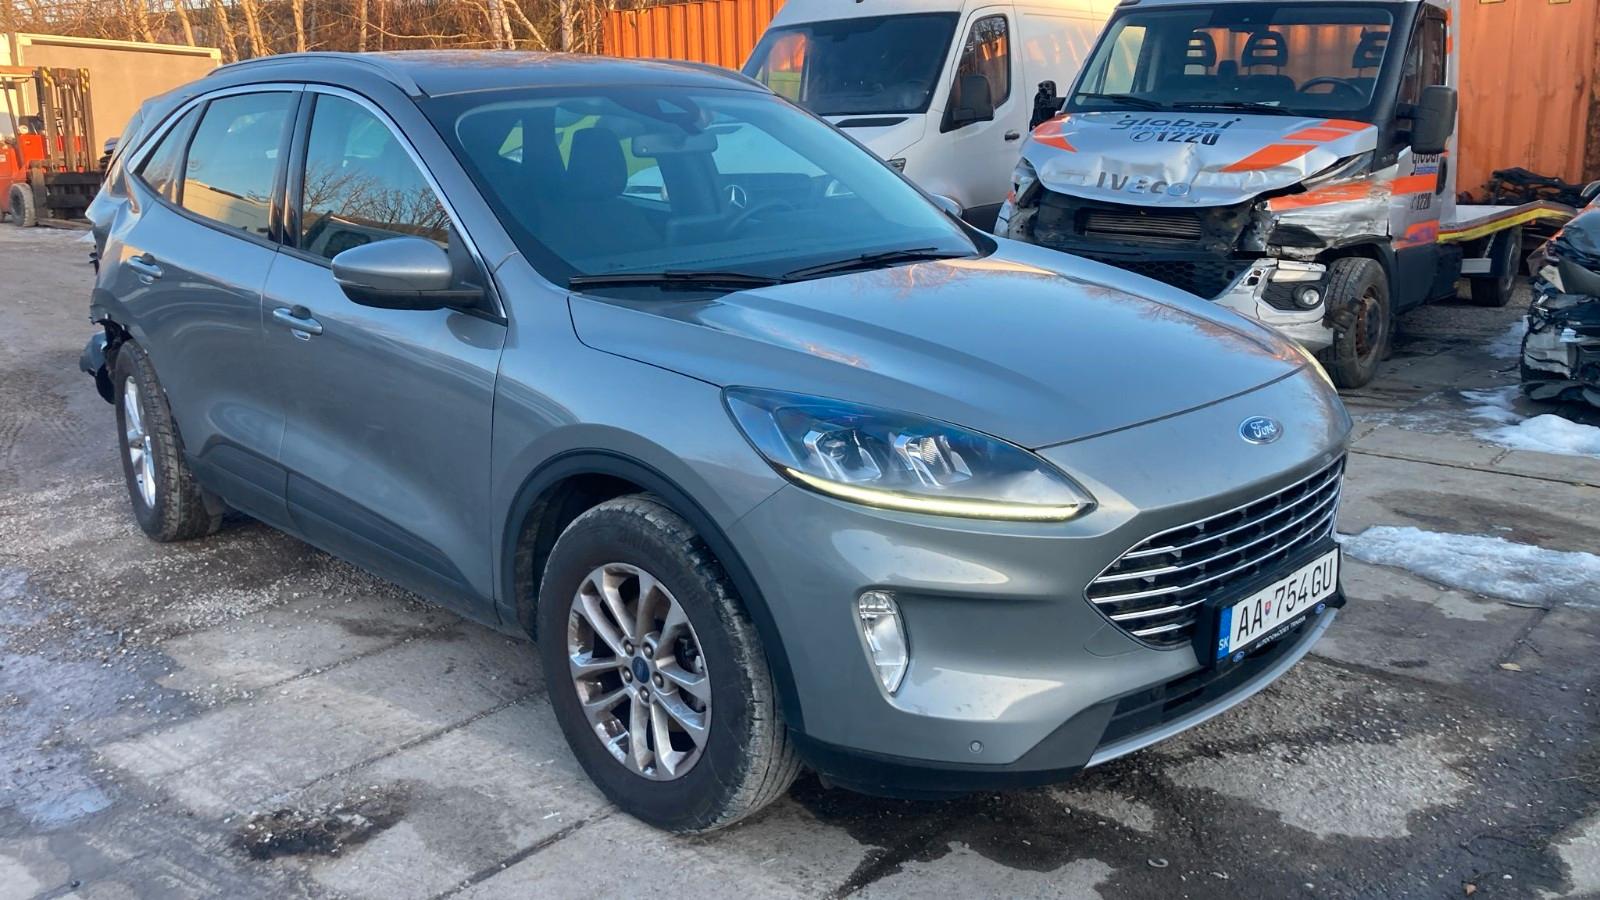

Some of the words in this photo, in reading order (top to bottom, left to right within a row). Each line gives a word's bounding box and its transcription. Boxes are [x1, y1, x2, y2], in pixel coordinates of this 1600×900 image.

[1110, 115, 1241, 130] global
[1157, 131, 1221, 146] 1220
[1096, 171, 1190, 197] IVECO
[1250, 419, 1277, 438] Ford
[1218, 636, 1230, 650] SK
